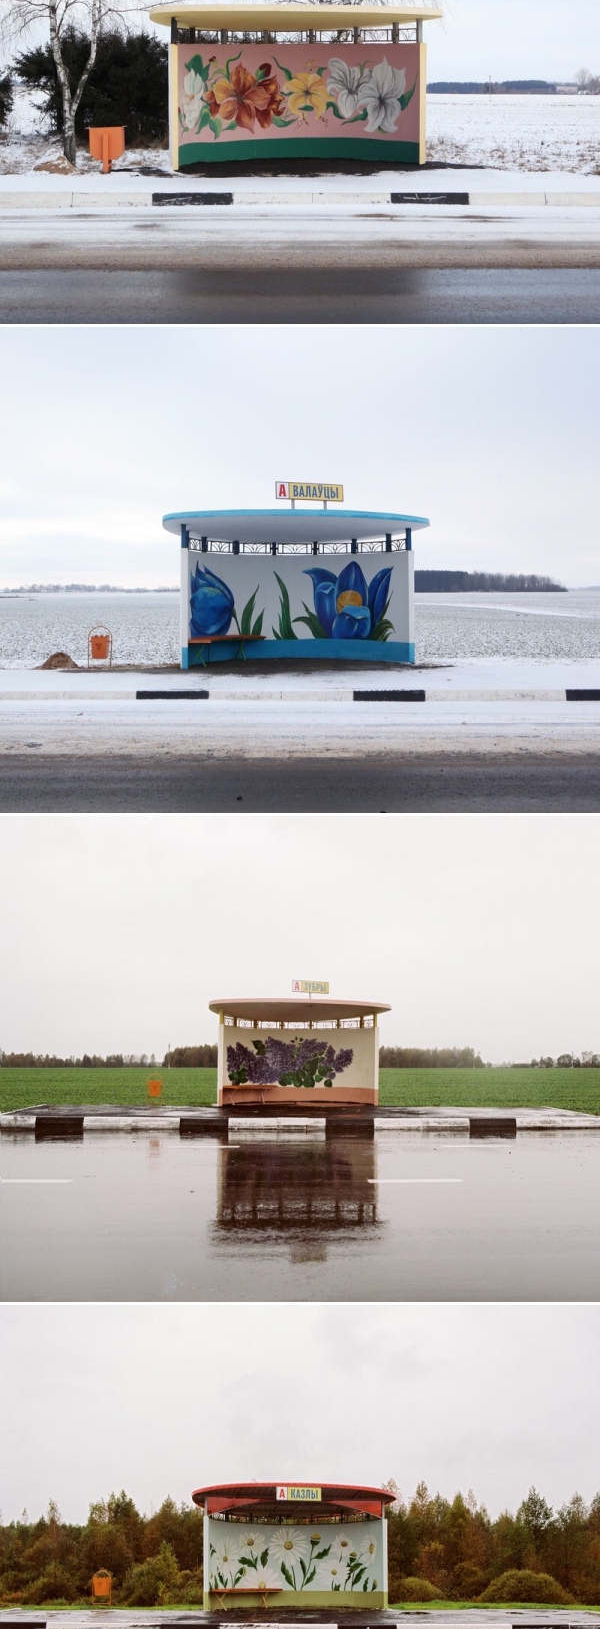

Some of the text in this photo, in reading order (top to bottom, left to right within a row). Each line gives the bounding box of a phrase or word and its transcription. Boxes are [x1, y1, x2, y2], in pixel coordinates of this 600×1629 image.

[293, 484, 338, 499] ВАЛАЎЦЫ
[304, 982, 326, 992] ЗУБРЫ
[291, 1489, 318, 1499] КАЗЛЫ
